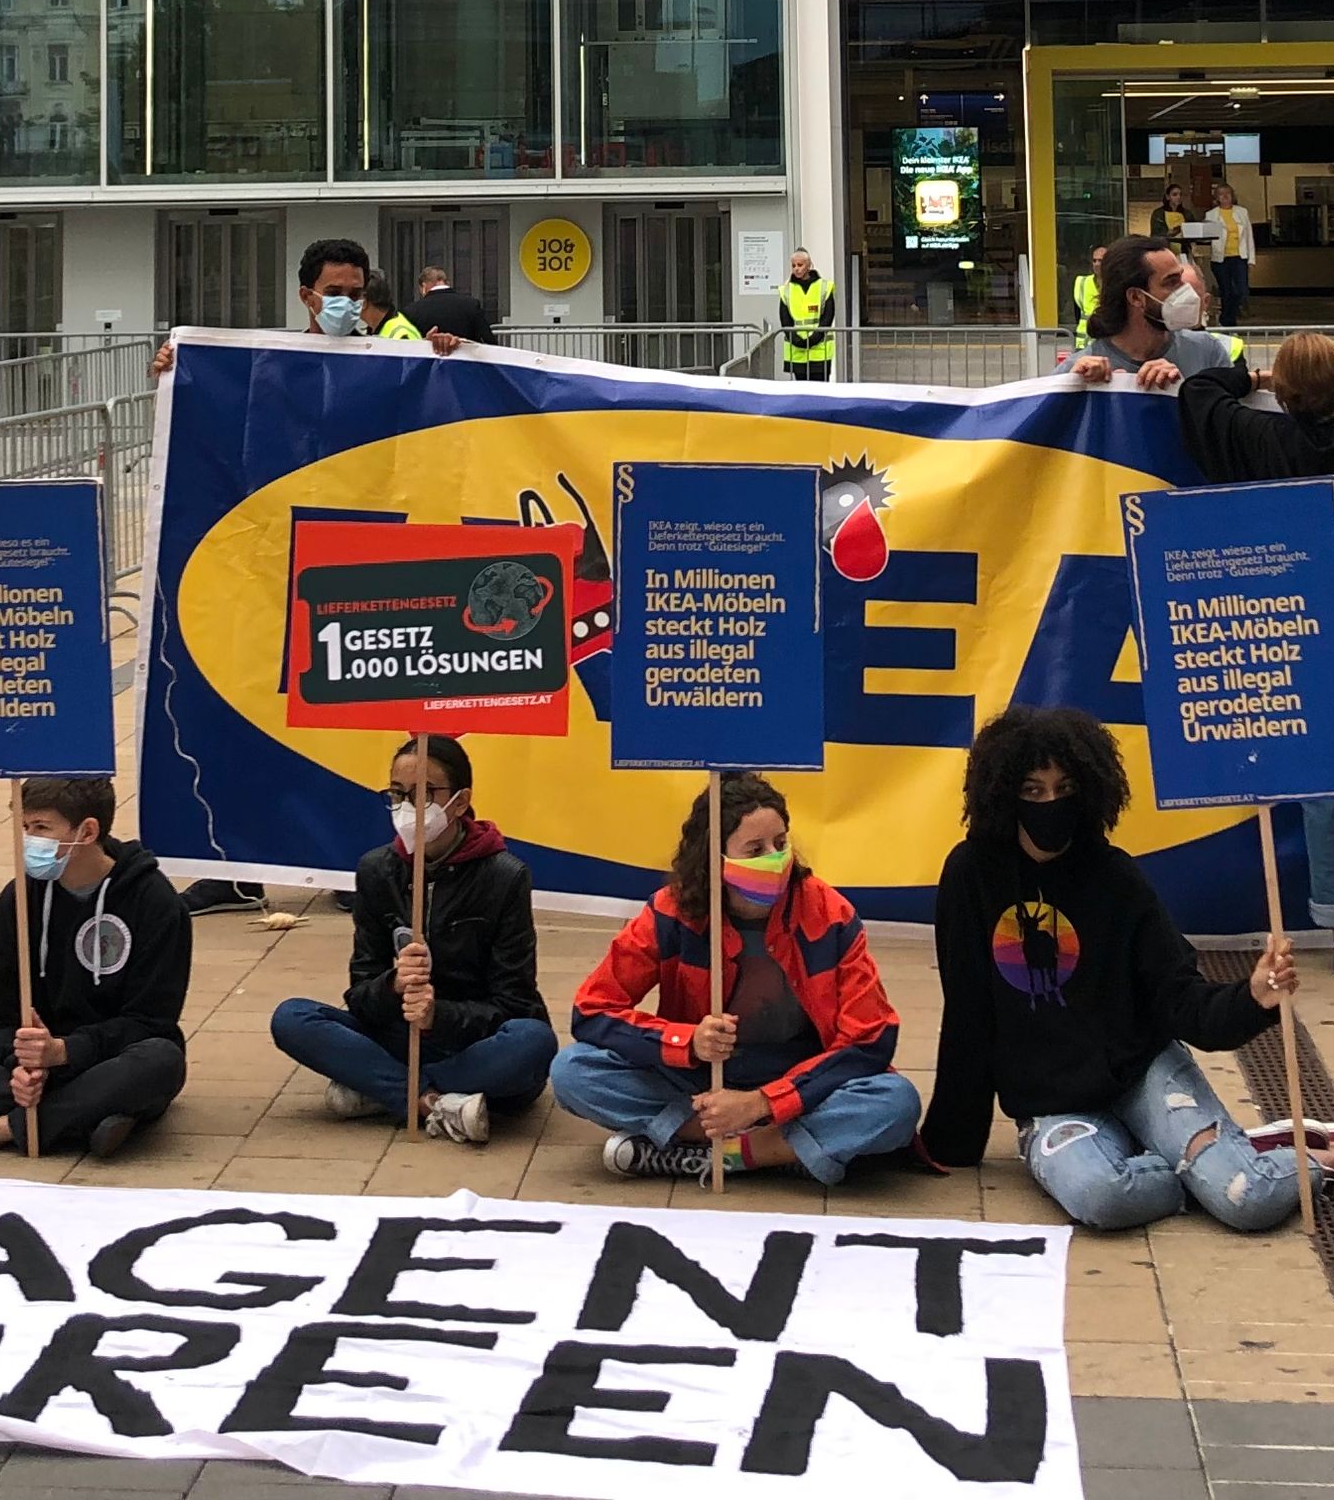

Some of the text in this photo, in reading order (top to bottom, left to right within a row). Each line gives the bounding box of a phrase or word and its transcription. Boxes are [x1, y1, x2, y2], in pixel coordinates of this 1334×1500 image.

[538, 238, 575, 253] JO&
[648, 520, 672, 530] IKEA
[703, 521, 732, 531] wieso
[748, 522, 764, 532] ein
[648, 531, 741, 543] Lieferkettengesetz
[648, 541, 675, 550] Denn
[677, 542, 701, 551] trotz
[1163, 549, 1189, 561] IKEA
[1221, 544, 1252, 556] wieso
[1255, 545, 1267, 554] es
[1268, 542, 1286, 553] ein
[1165, 554, 1263, 573] Lieferkettengesetz
[645, 568, 775, 590] In Millionen
[1166, 570, 1195, 581] Denn
[1196, 569, 1222, 579] trotz
[317, 596, 457, 614] LIEFERKETTENGESETZ
[645, 591, 785, 613] IKEA-Möbeln
[1166, 590, 1305, 621] In Millionen
[645, 615, 766, 636] steckt Holz
[1169, 614, 1319, 645] IKEA-Möbeln
[9, 629, 56, 649] Holz
[345, 626, 433, 650] GESETZ
[405, 648, 542, 676] LÖSUNGEN
[645, 639, 754, 665] aus illegal
[1172, 640, 1302, 669] steckt Holz
[645, 663, 759, 688] gerodeten
[1176, 665, 1293, 695] aus illegal
[424, 695, 552, 710] LIEFERKETTENGESETZ.AT
[645, 684, 762, 707] Urwäldern
[1178, 690, 1302, 723] gerodeten
[1181, 711, 1307, 742] Urwäldern
